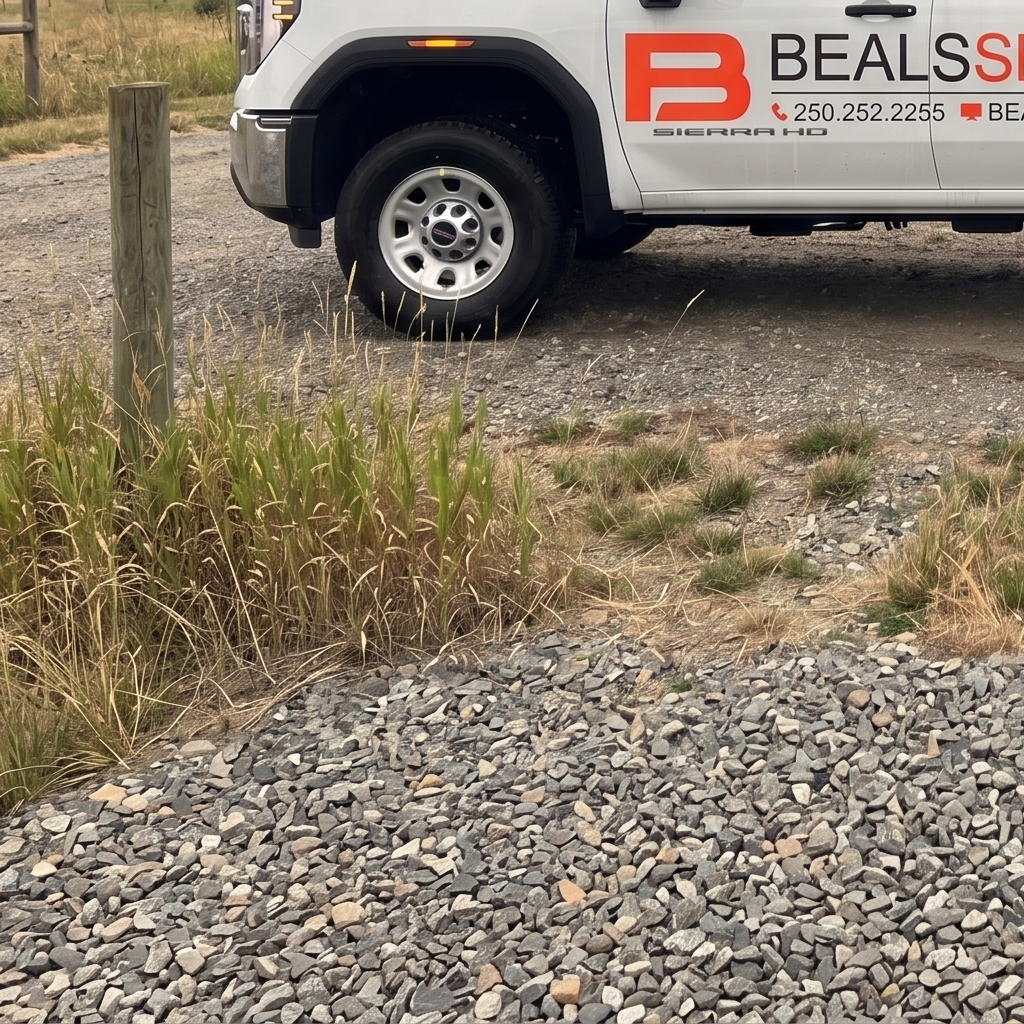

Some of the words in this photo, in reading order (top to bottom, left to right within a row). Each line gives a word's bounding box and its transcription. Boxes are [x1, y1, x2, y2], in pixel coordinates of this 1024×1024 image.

[794, 103, 945, 122] 250.252.2255
[653, 128, 775, 136] SIERRA
[783, 128, 828, 136] HD
